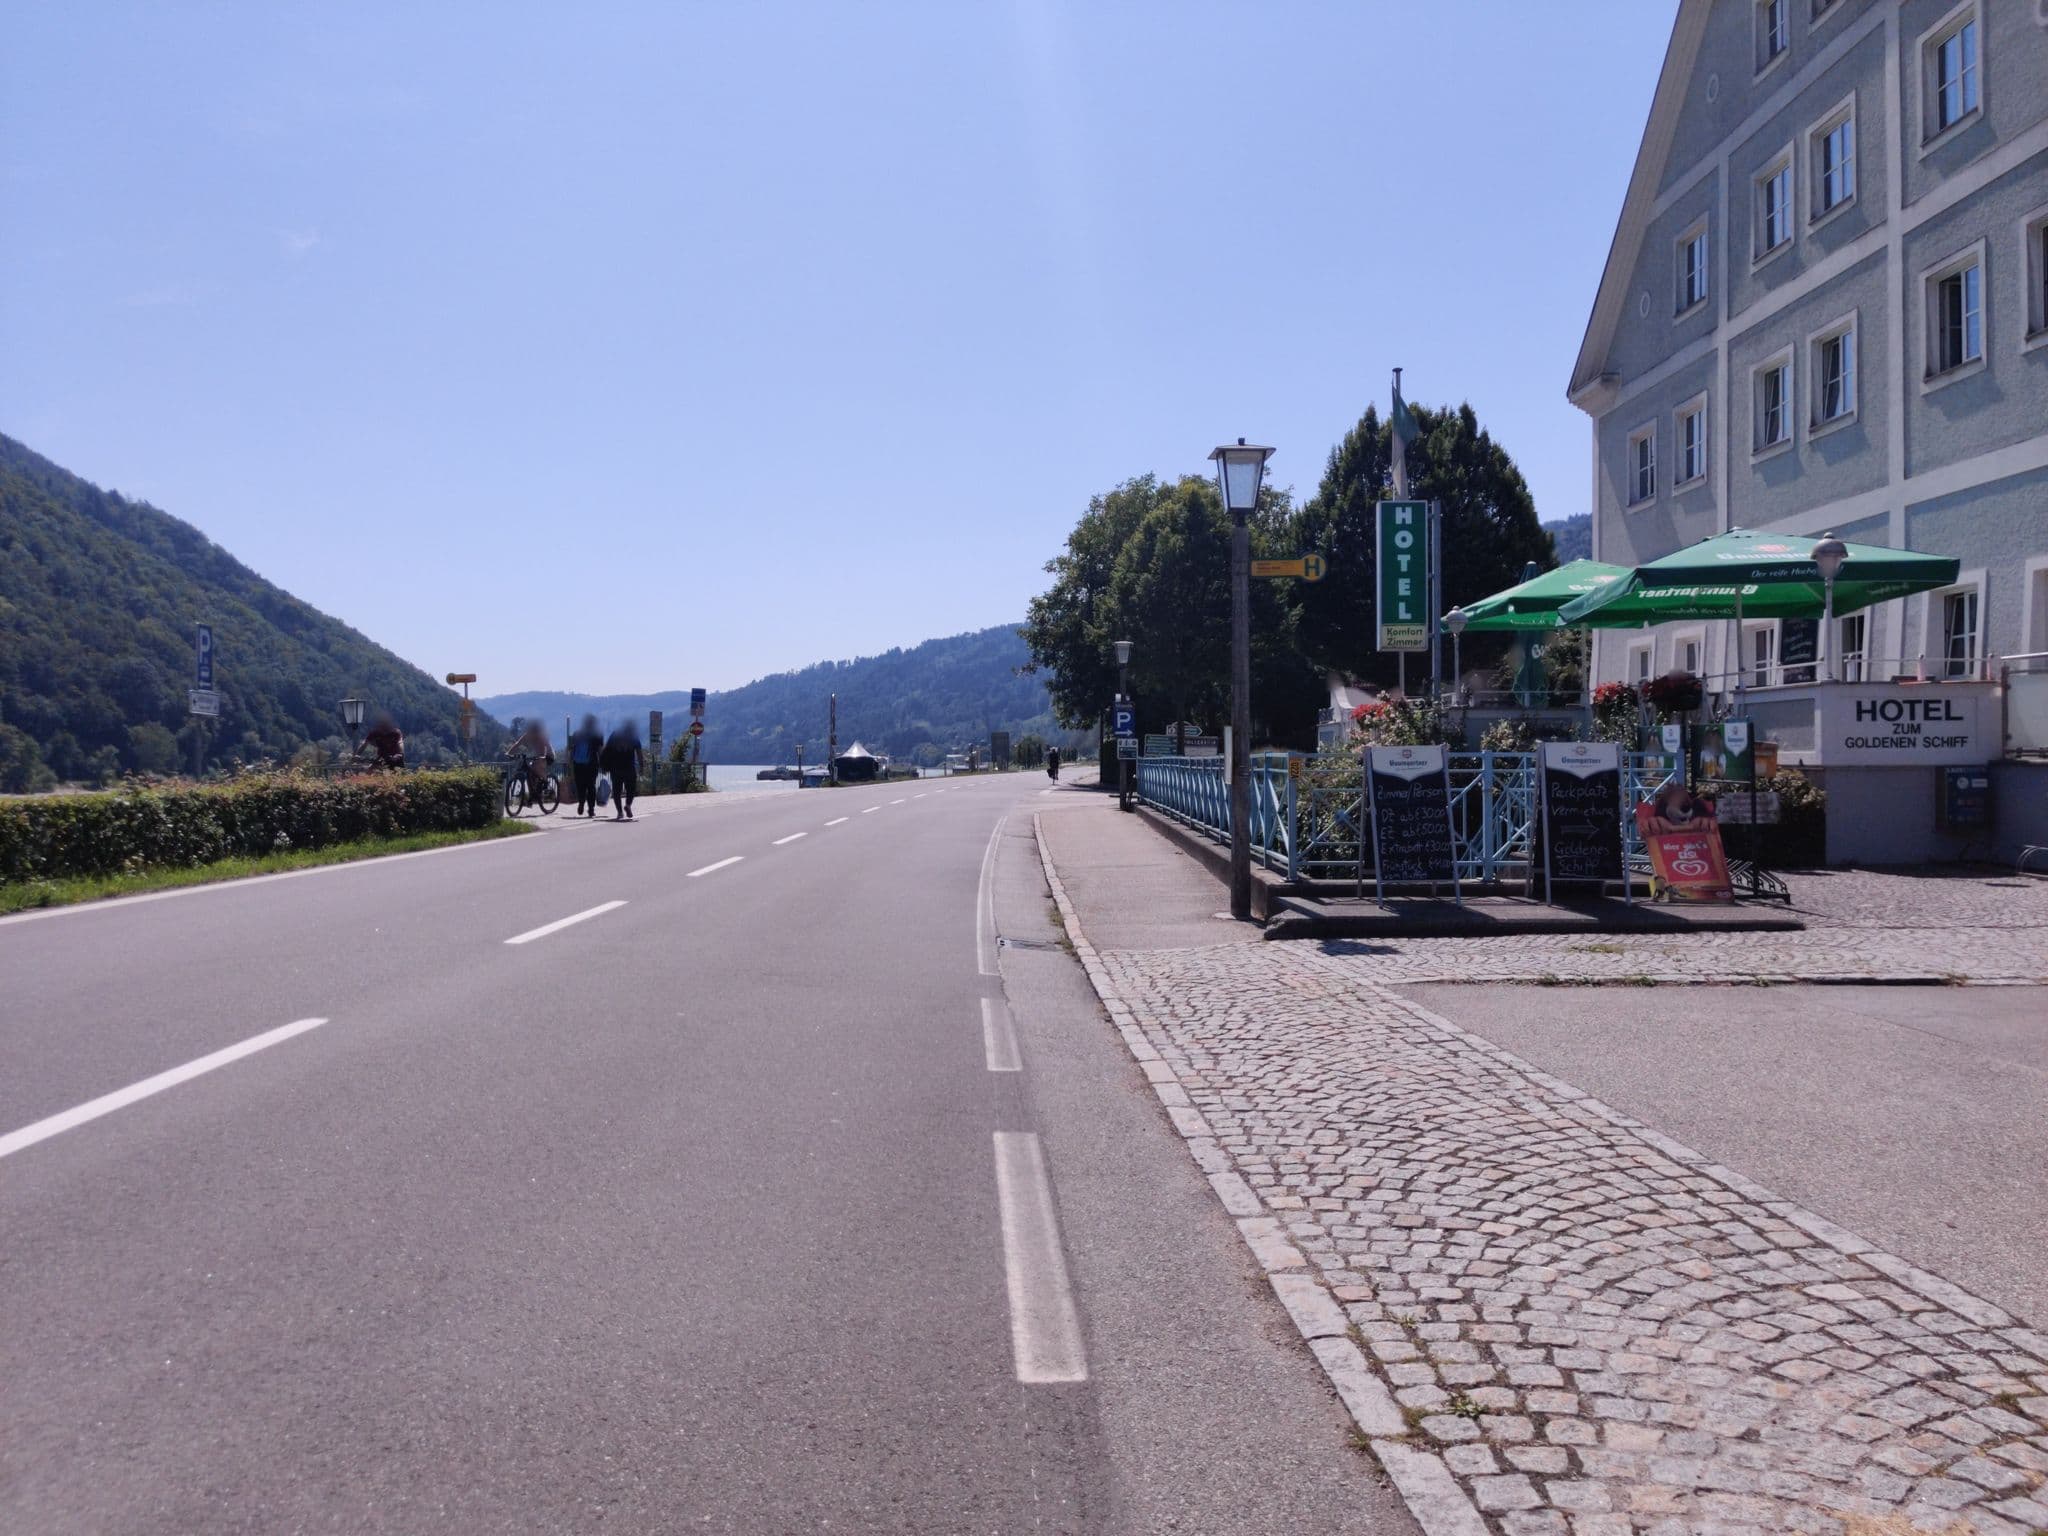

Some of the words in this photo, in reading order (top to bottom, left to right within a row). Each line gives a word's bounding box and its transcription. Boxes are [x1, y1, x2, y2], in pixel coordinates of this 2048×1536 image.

[1304, 557, 1321, 577] H
[1394, 506, 1414, 620] HOTEL
[1386, 627, 1423, 637] Komfort
[199, 627, 211, 663] P
[1387, 637, 1423, 647] Zimmer
[1856, 699, 1964, 721] HOTEL
[1116, 711, 1131, 728] P
[1892, 723, 1921, 735] ZUM
[1844, 736, 1917, 749] GOLDENEN
[1922, 736, 1969, 748] SCHIFF
